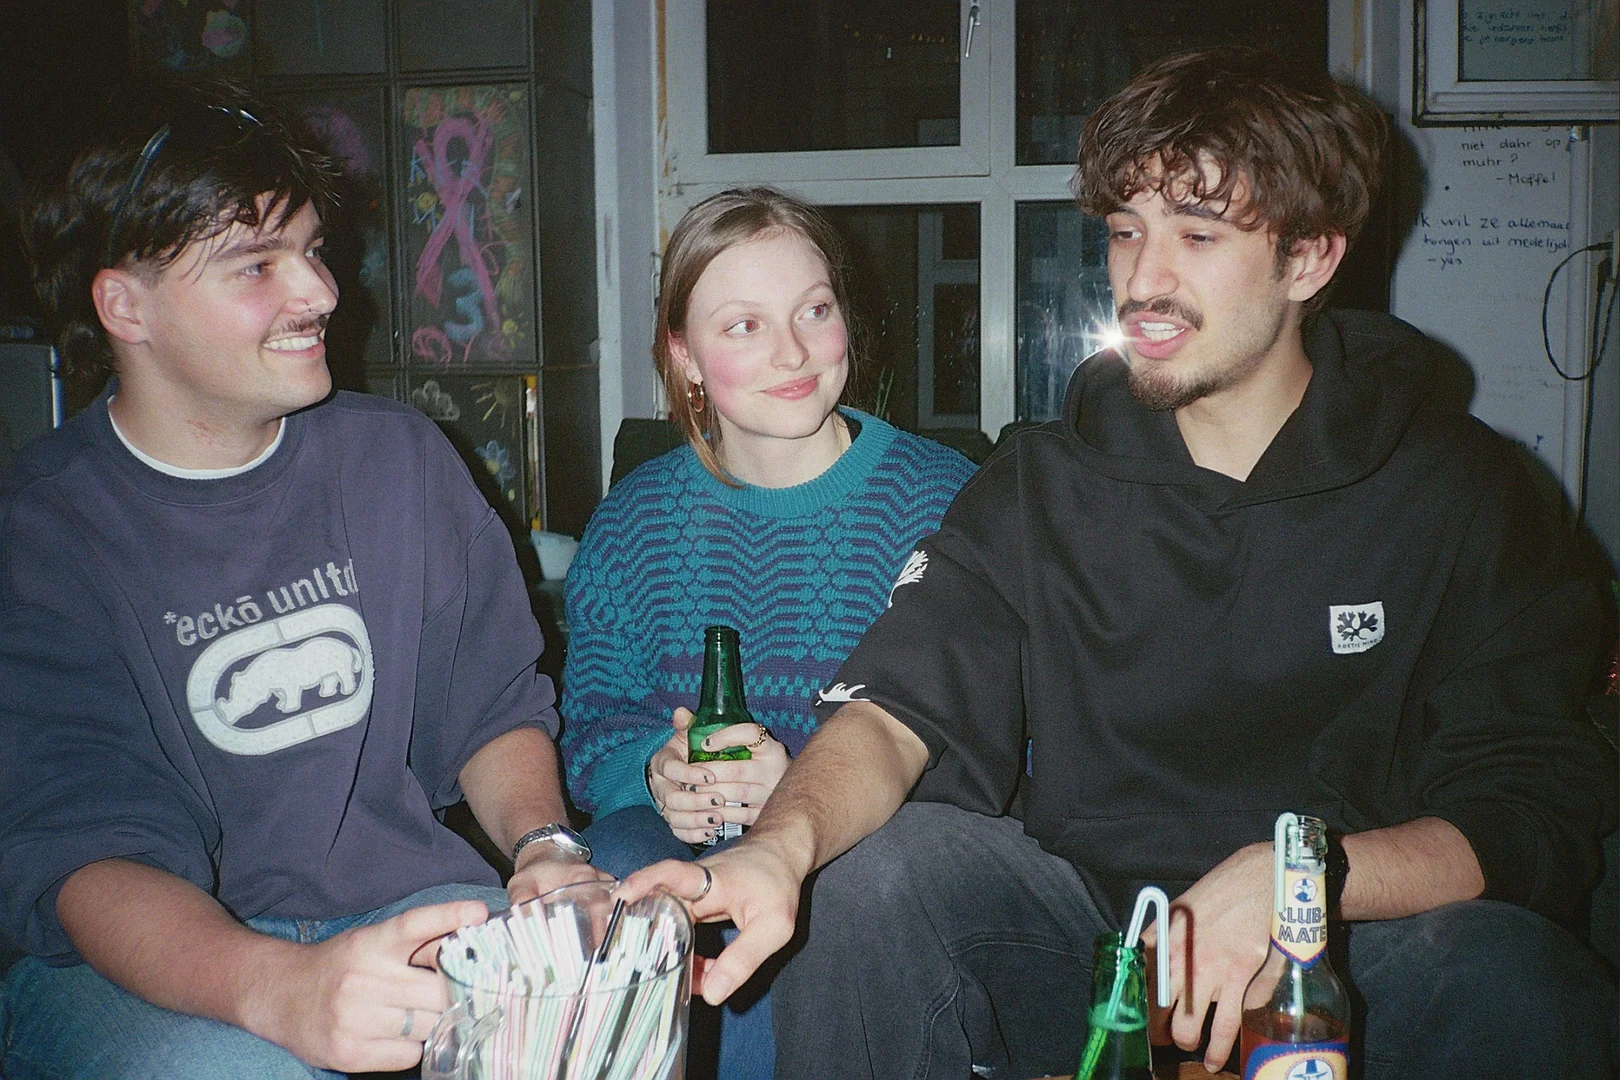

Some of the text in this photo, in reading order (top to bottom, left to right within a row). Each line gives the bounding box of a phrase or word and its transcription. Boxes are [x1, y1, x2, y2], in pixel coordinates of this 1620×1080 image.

[1462, 138, 1560, 151] niet dahr op
[1441, 213, 1470, 228] wil
[1480, 217, 1499, 229] ze
[1277, 924, 1327, 944] MATE
